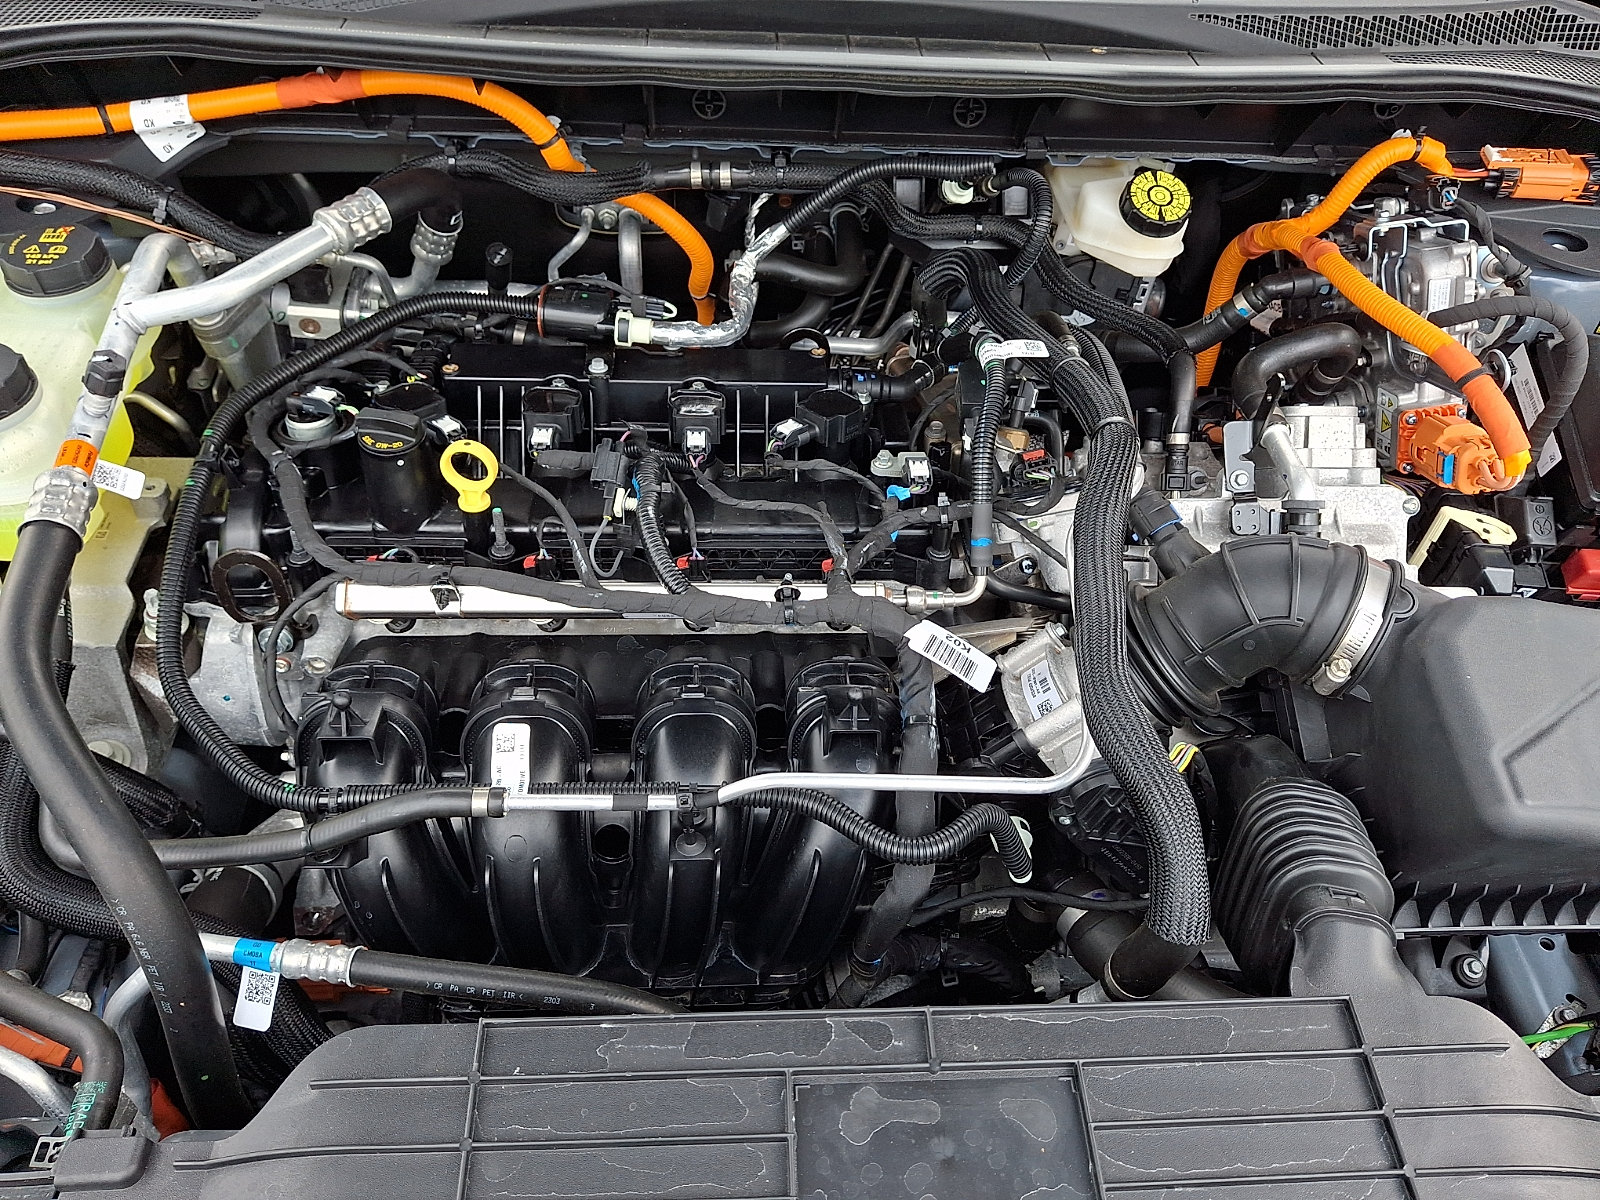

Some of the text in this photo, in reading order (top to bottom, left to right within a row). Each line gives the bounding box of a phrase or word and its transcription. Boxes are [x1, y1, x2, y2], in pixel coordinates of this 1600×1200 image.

[946, 634, 971, 654] K02
[450, 984, 458, 992] PA
[466, 986, 475, 994] CR
[482, 988, 495, 997] PET
